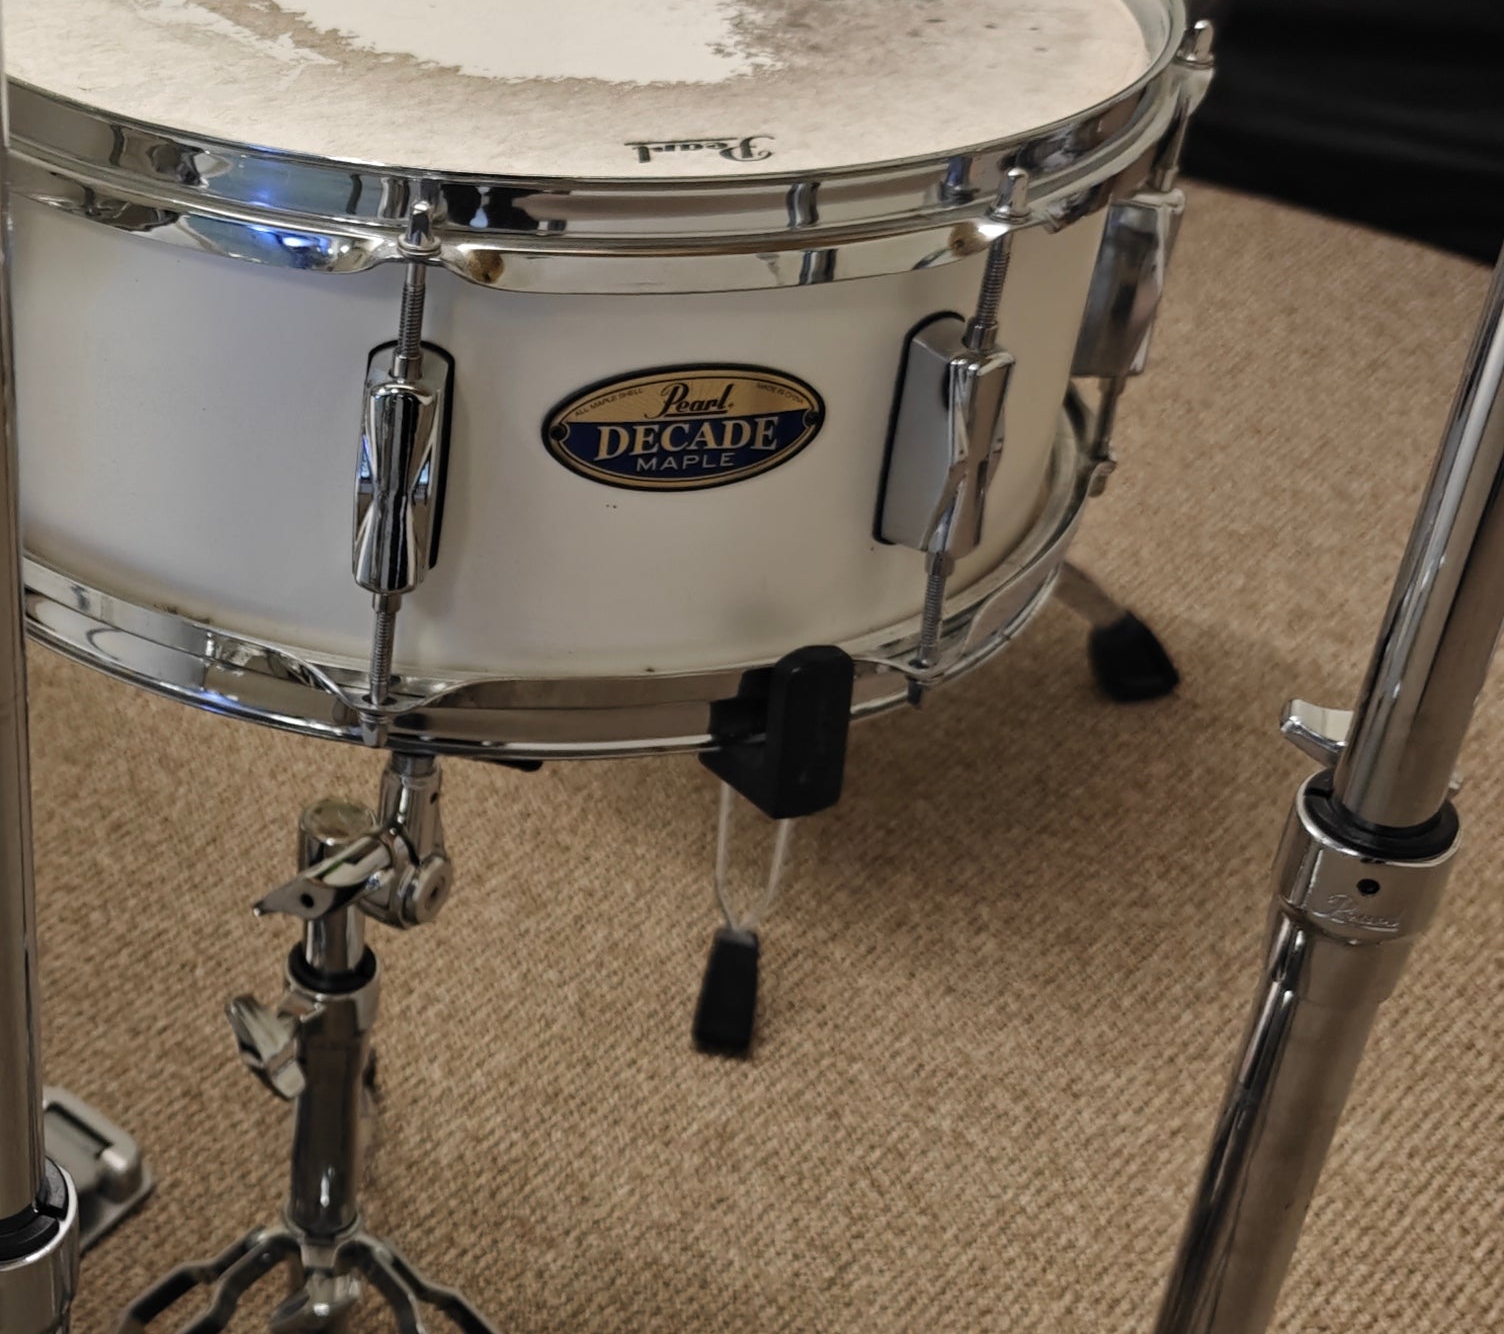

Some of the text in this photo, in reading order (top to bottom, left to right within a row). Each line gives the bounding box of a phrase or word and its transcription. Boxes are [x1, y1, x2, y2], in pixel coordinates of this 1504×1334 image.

[624, 135, 776, 164] Pearl
[644, 381, 735, 419] Pearl
[594, 417, 779, 462] DECADE
[636, 452, 736, 473] MAPLE
